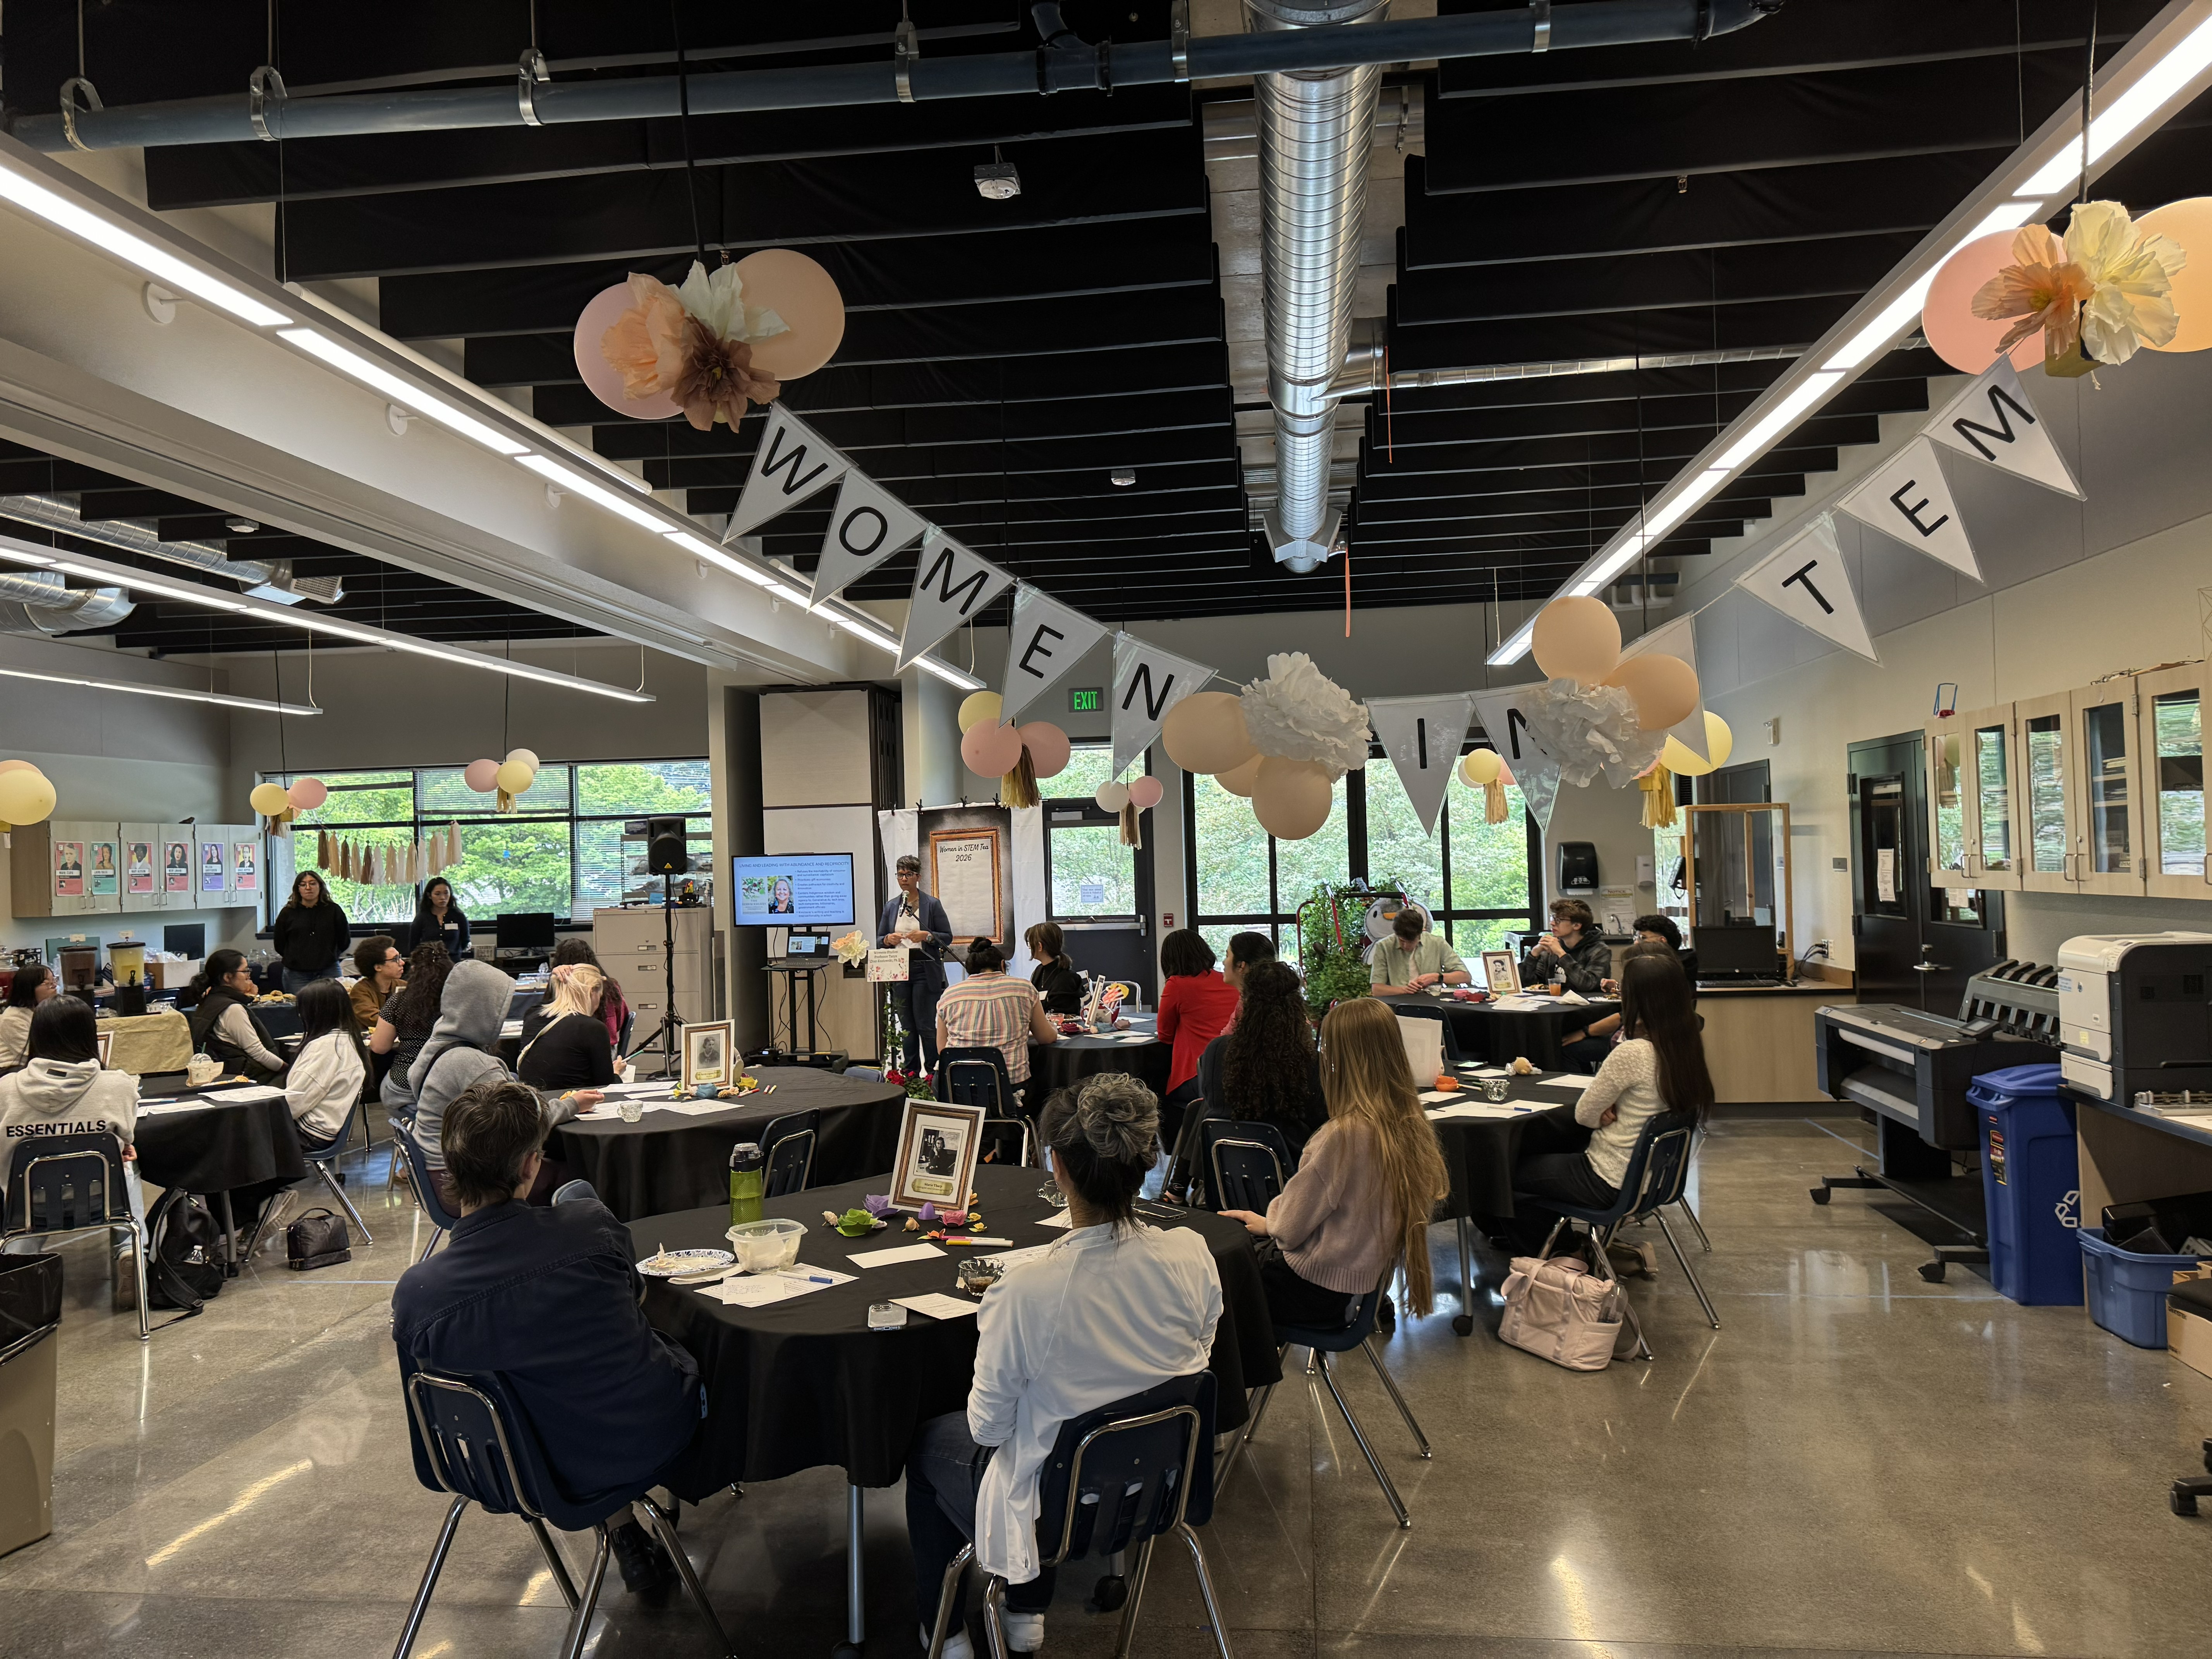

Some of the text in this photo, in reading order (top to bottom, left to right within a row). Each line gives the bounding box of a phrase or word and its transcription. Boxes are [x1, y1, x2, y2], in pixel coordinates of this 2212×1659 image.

[761, 426, 1175, 721] WOMEN
[1781, 384, 2036, 615] TEM
[1074, 691, 1097, 710] EXIT
[7, 1120, 106, 1137] ESSENTIALS
